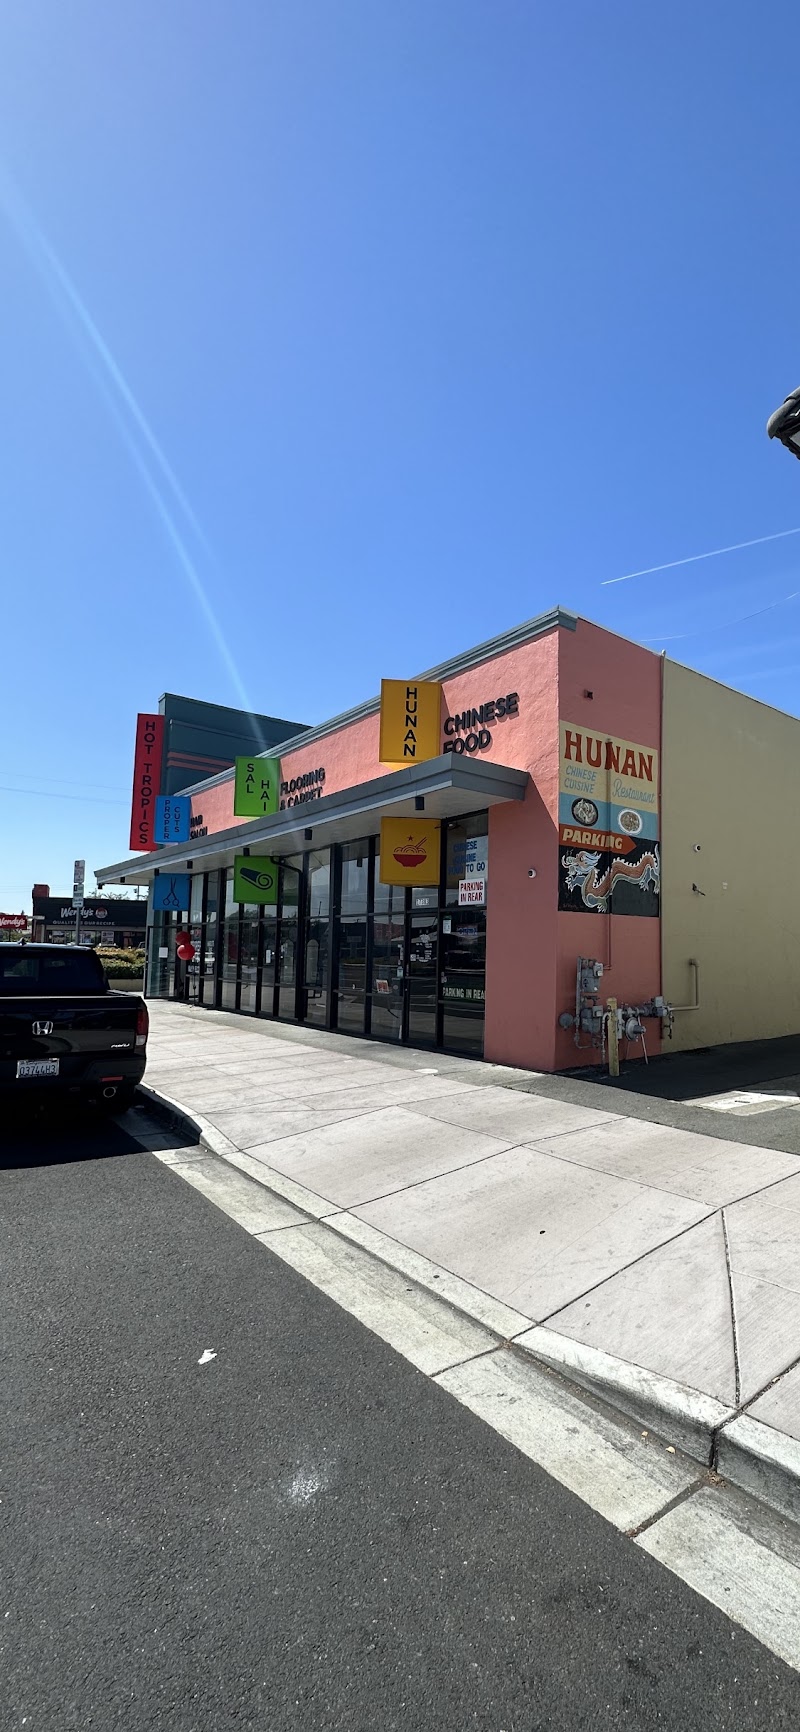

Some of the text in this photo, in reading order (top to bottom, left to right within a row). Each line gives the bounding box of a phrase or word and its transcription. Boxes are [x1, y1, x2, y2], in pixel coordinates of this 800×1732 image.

[404, 687, 417, 757] HUNAN
[443, 692, 519, 736] CHINESE
[443, 729, 492, 755] FOOD
[564, 729, 654, 782] HUNAN
[139, 721, 156, 845] HOT TROPICS
[246, 763, 255, 794] SAL
[280, 767, 326, 796] FLOORING
[564, 778, 595, 794] CUISINE
[565, 765, 598, 781] CHINESE
[260, 779, 270, 812] HAI
[612, 778, 655, 804] Restaurant
[163, 800, 171, 840] PROPER
[562, 828, 623, 850] PARKING
[466, 864, 474, 873] TO
[476, 862, 486, 871] GO
[460, 881, 484, 892] PARKING
[461, 892, 483, 903] IN REAR
[442, 987, 486, 999] PARKING IN REA
